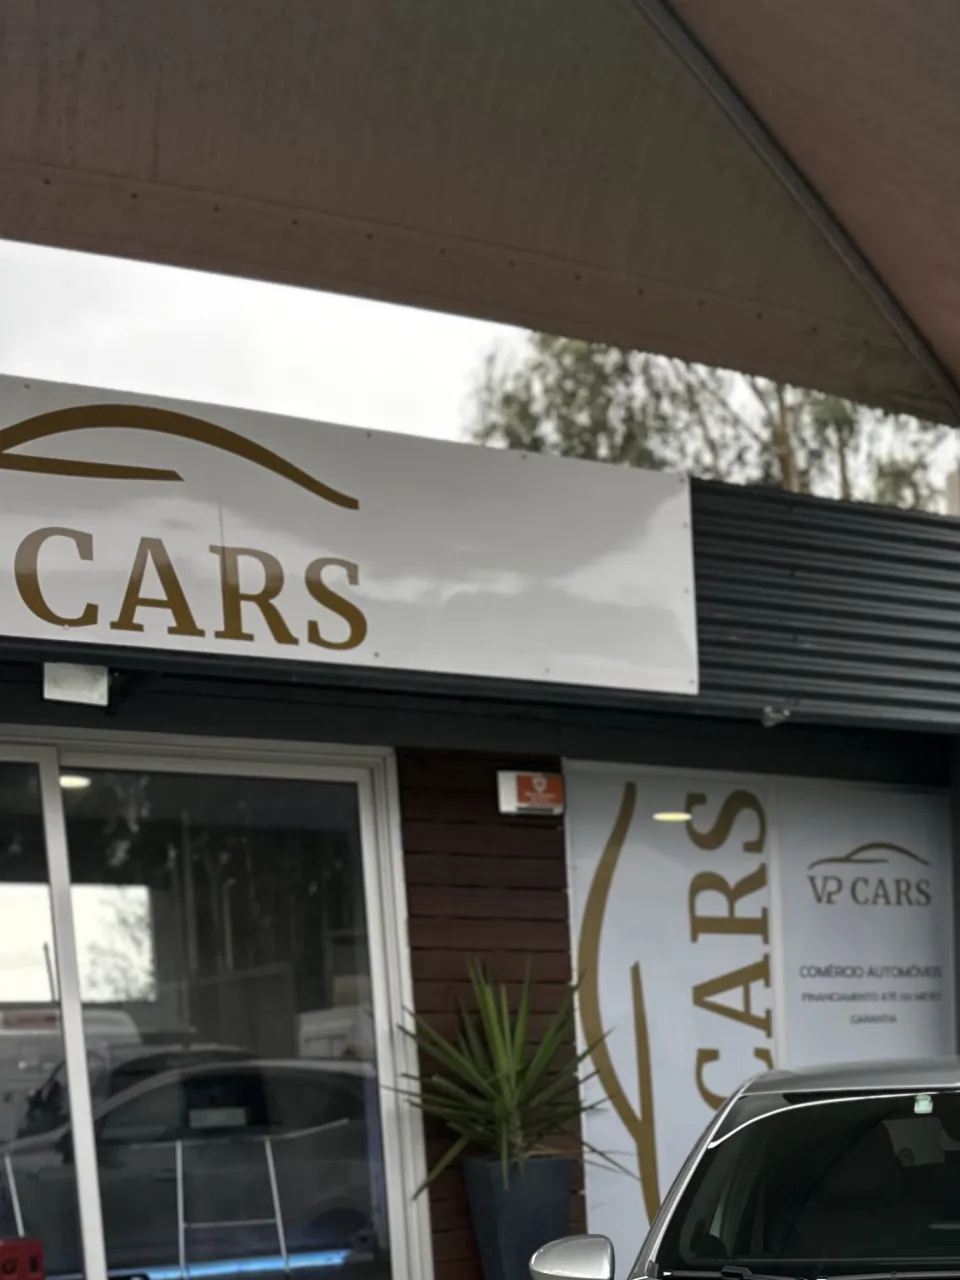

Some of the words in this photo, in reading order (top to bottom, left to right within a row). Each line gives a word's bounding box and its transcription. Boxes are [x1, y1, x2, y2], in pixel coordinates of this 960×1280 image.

[13, 526, 368, 650] CARS
[806, 875, 843, 904] VP
[850, 876, 931, 906] CARS
